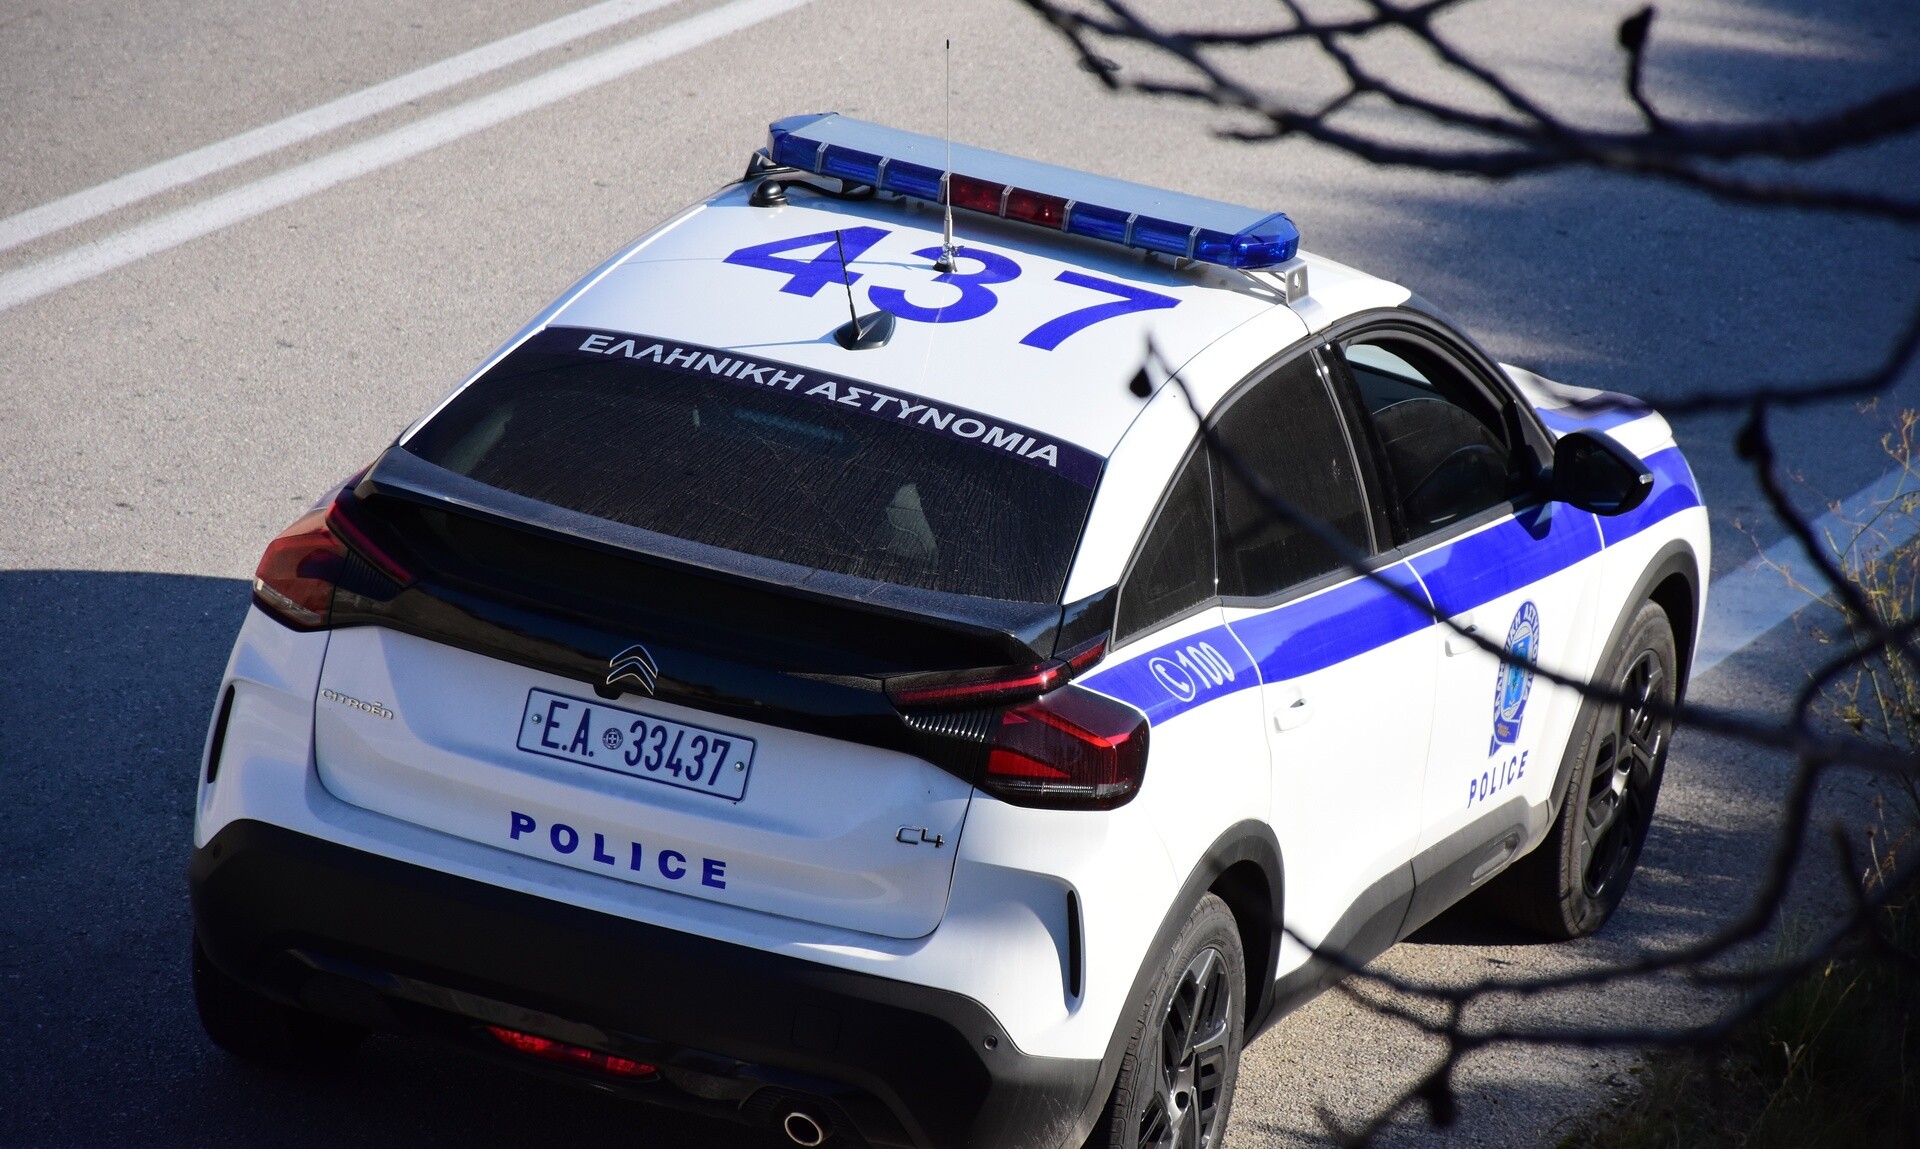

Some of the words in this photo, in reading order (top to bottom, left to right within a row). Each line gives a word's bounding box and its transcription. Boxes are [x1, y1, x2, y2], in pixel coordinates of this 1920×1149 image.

[722, 226, 1183, 351] 437
[578, 333, 804, 391] ΕΛΛΗΝΙΚΗ
[804, 381, 1058, 468] ΑΣΤΥΝΟΜΙΑ
[1175, 641, 1235, 689] 100
[1522, 602, 1539, 701] ΑΣΤΥΝΟΙΑ
[624, 720, 731, 786] 33437
[1467, 749, 1529, 809] POLICE
[510, 811, 728, 890] POLICE
[896, 825, 945, 848] C4
